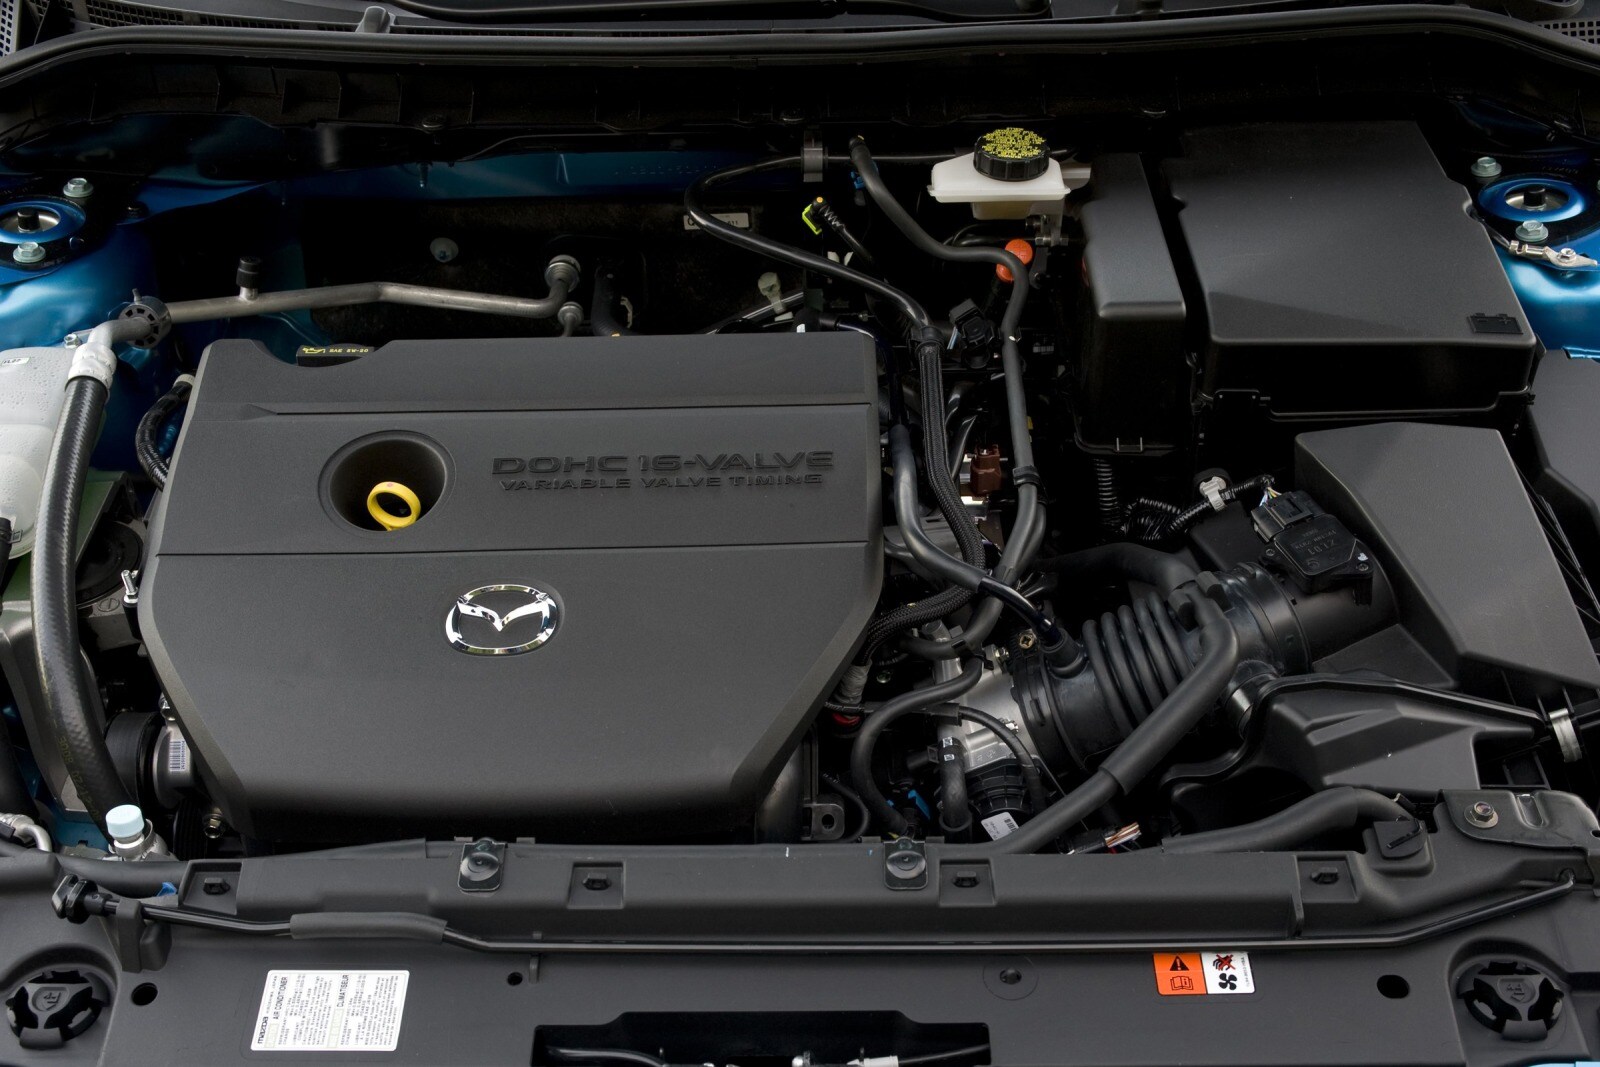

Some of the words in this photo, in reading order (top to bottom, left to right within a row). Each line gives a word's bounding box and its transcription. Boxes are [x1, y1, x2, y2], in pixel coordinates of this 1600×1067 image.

[492, 455, 628, 475] DOHC
[638, 450, 834, 472] 16-VALVE
[500, 478, 631, 491] VARIABLE
[640, 475, 721, 488] VALVE
[728, 473, 824, 486] TIMING
[275, 976, 288, 1009] CONDITIONER
[337, 974, 349, 1006] CLIMATISEUR
[257, 1016, 268, 1043] mazda
